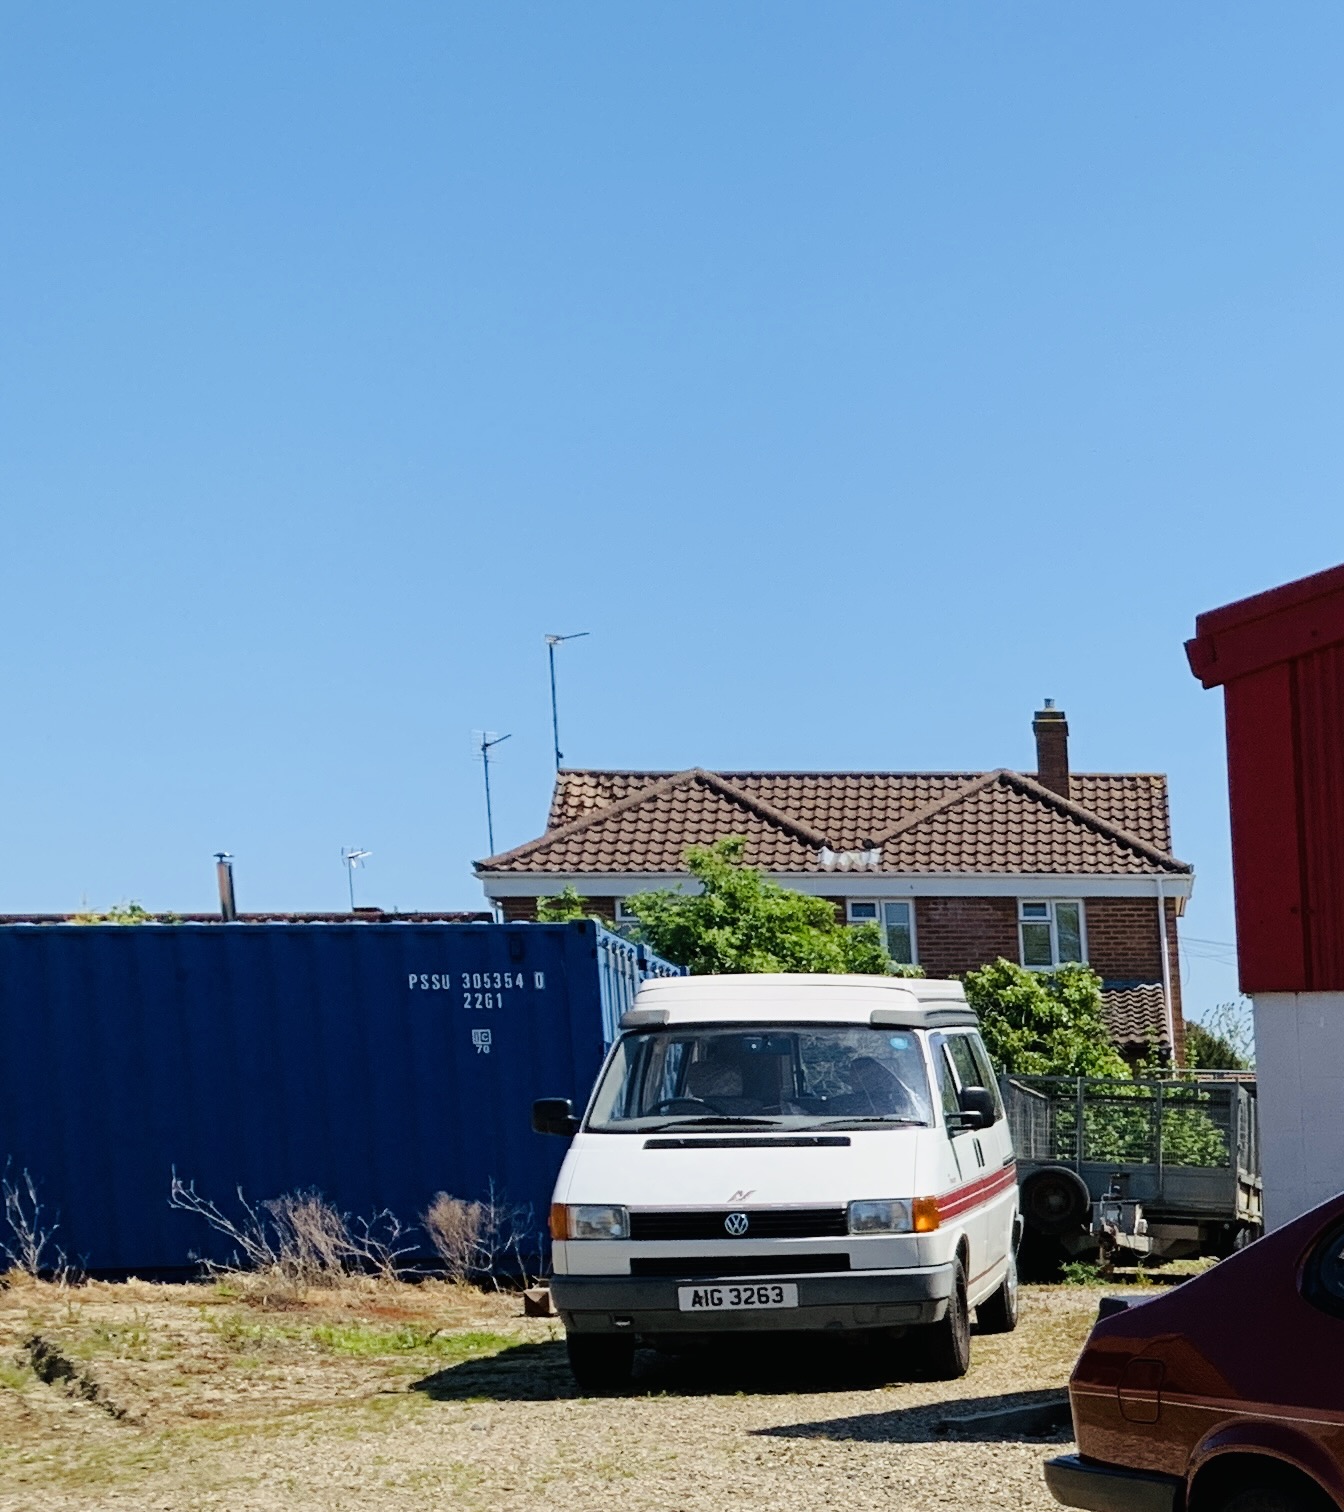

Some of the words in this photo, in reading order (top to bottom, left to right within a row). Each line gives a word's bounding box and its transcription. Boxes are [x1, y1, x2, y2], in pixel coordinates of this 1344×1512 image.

[408, 973, 450, 990] PSSU
[461, 972, 524, 989] 305354
[463, 993, 503, 1009] 22G1
[692, 1288, 723, 1308] AIG
[728, 1285, 784, 1306] 3263
